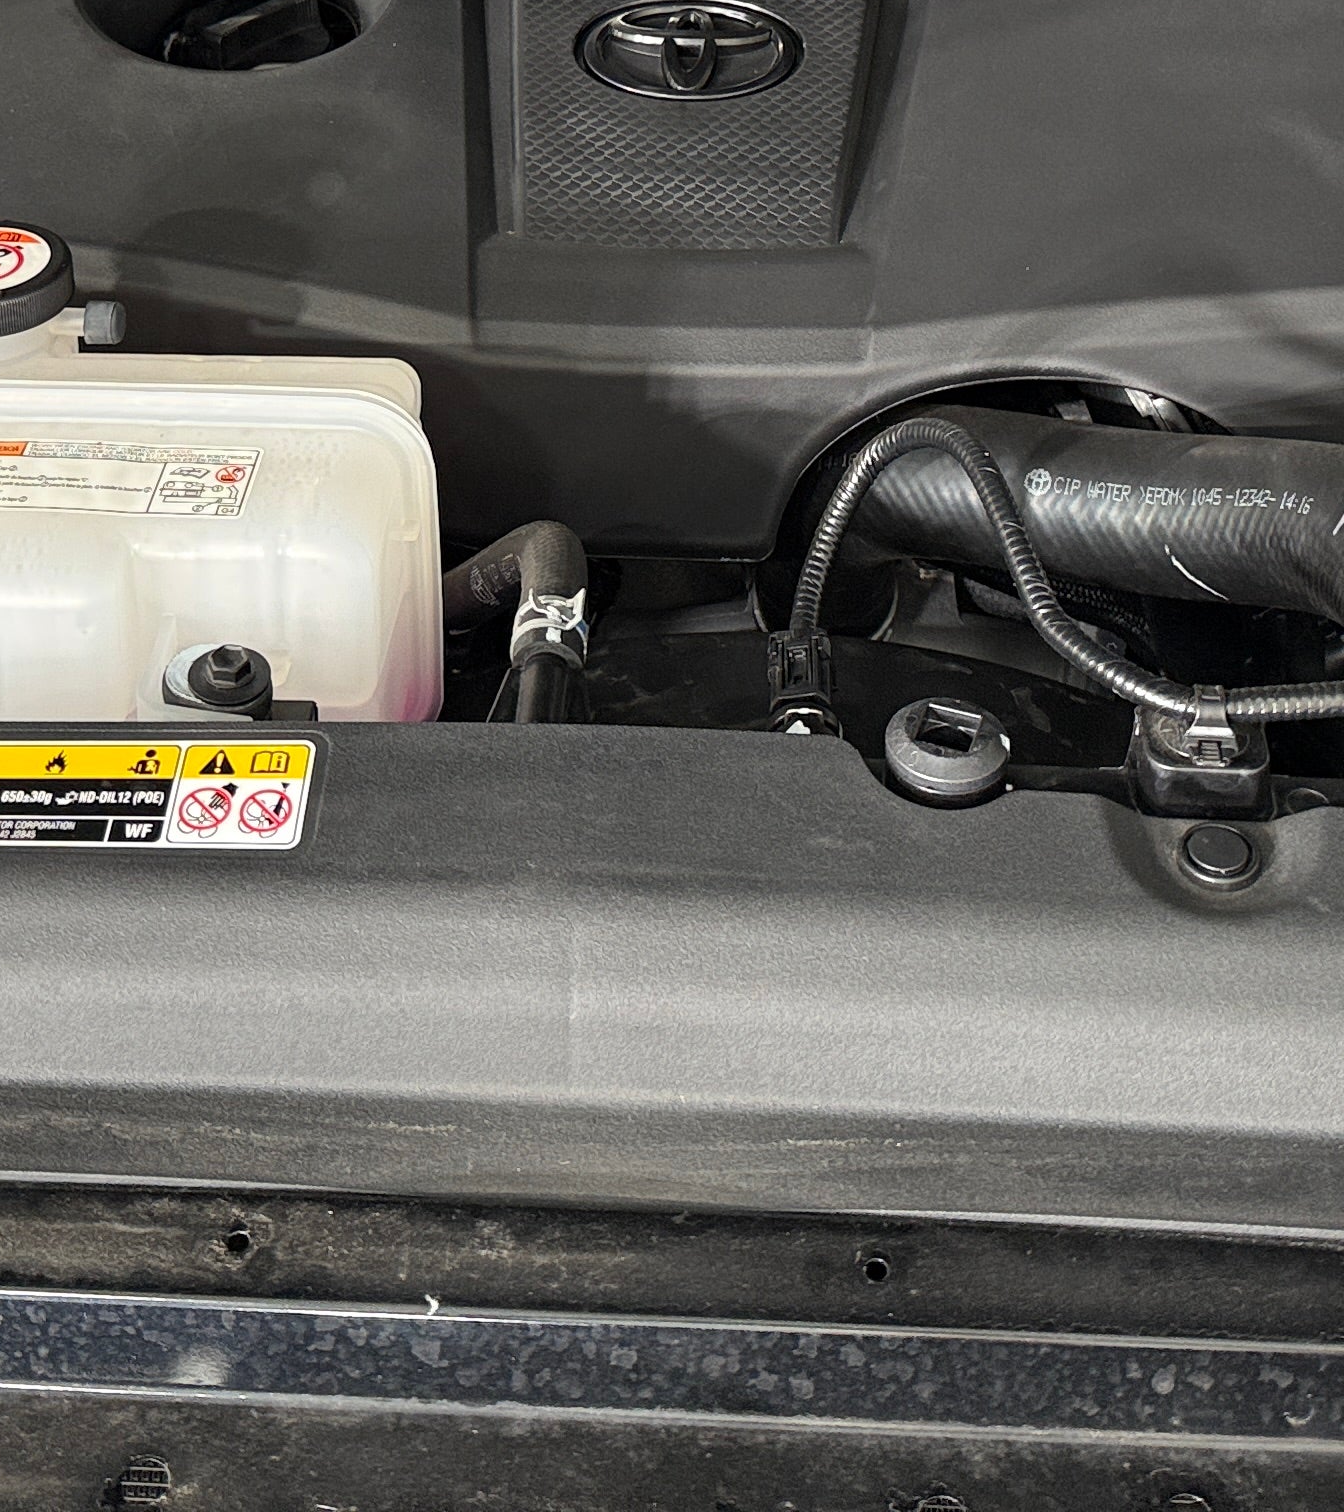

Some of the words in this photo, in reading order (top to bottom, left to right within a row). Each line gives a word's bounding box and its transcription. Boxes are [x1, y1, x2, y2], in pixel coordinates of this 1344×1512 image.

[1053, 476, 1081, 495] CIP
[1087, 481, 1131, 502] WATER
[1278, 495, 1314, 515] 14:16
[1, 790, 53, 806] 650±30g
[79, 791, 131, 805] ND-OIL12
[132, 790, 165, 807] (POE)
[13, 820, 76, 831] CORPORATION
[124, 823, 152, 839] WF
